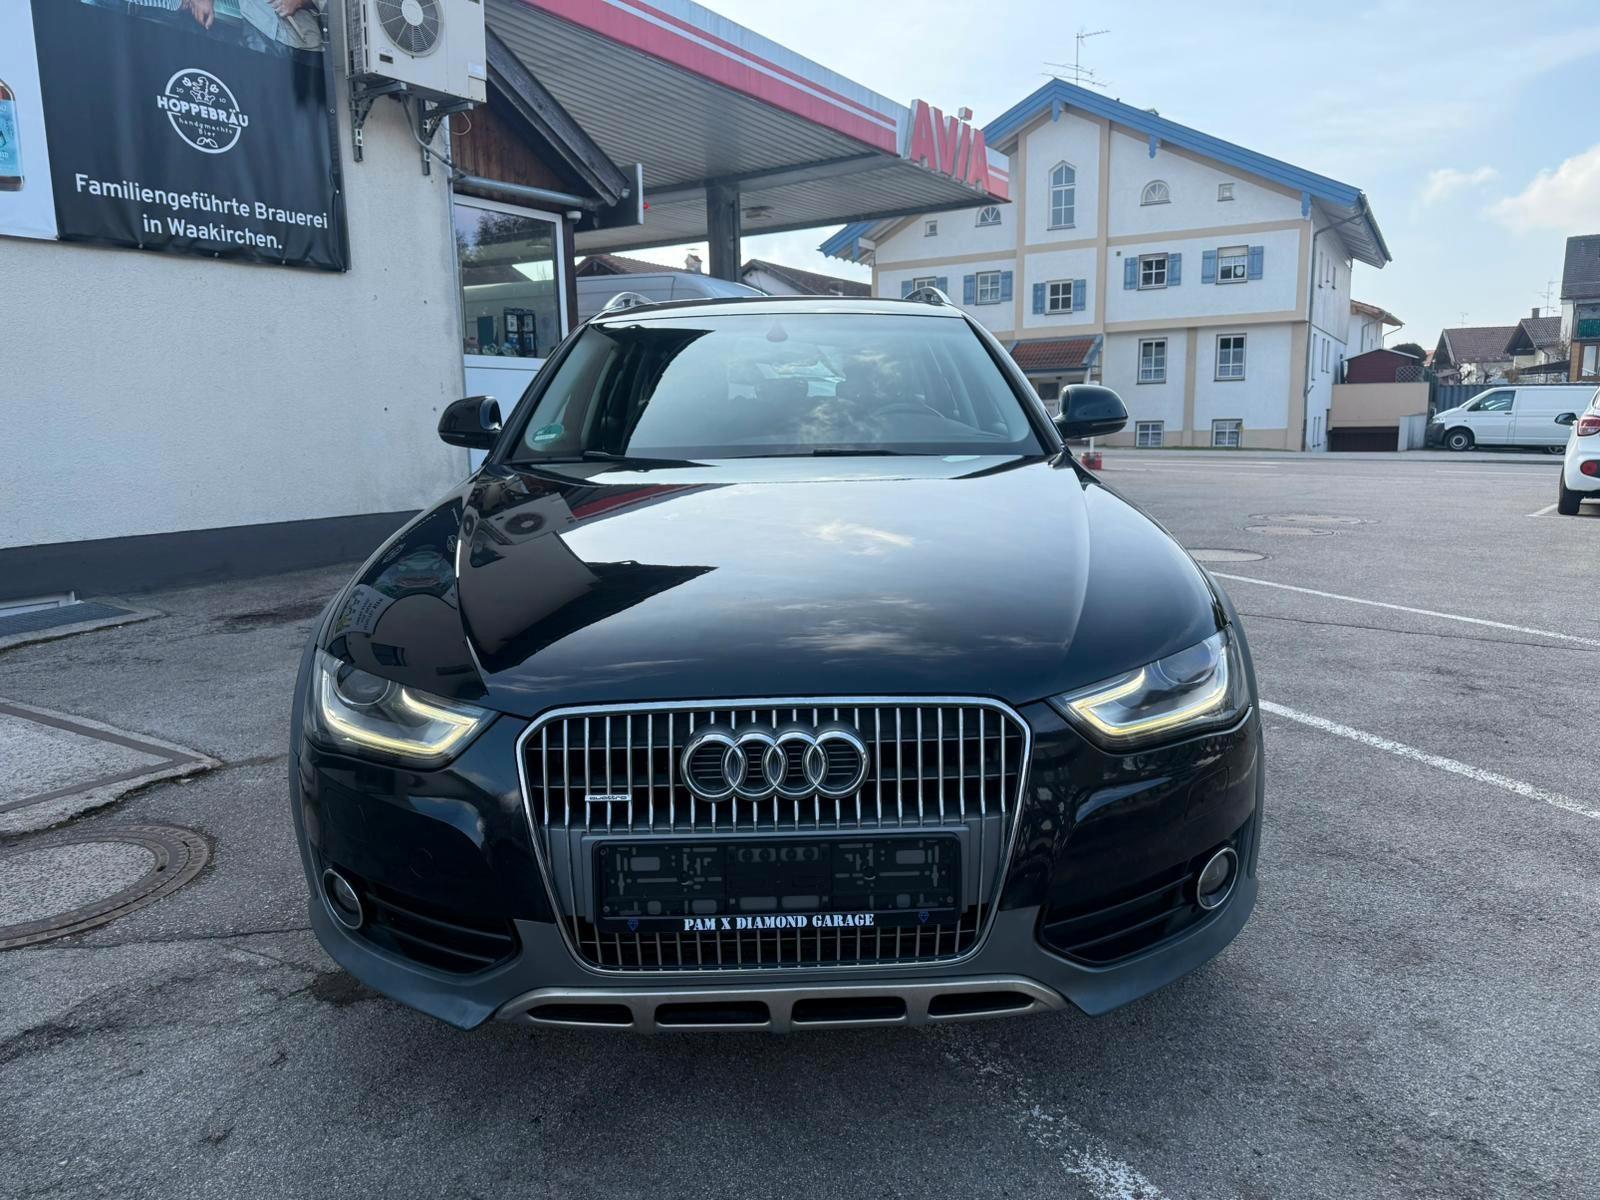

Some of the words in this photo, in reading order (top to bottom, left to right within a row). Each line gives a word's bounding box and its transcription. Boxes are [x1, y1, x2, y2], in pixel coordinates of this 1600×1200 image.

[156, 95, 249, 127] HOPPEBRÄU
[75, 173, 250, 217] Familiengeführte
[254, 202, 328, 229] Brauerei
[142, 214, 162, 234] in
[167, 218, 283, 250] Waakirchen.
[683, 918, 716, 932] PAM
[721, 917, 731, 931] X
[736, 915, 808, 930] DIAMOND
[812, 913, 875, 928] GARAGE
